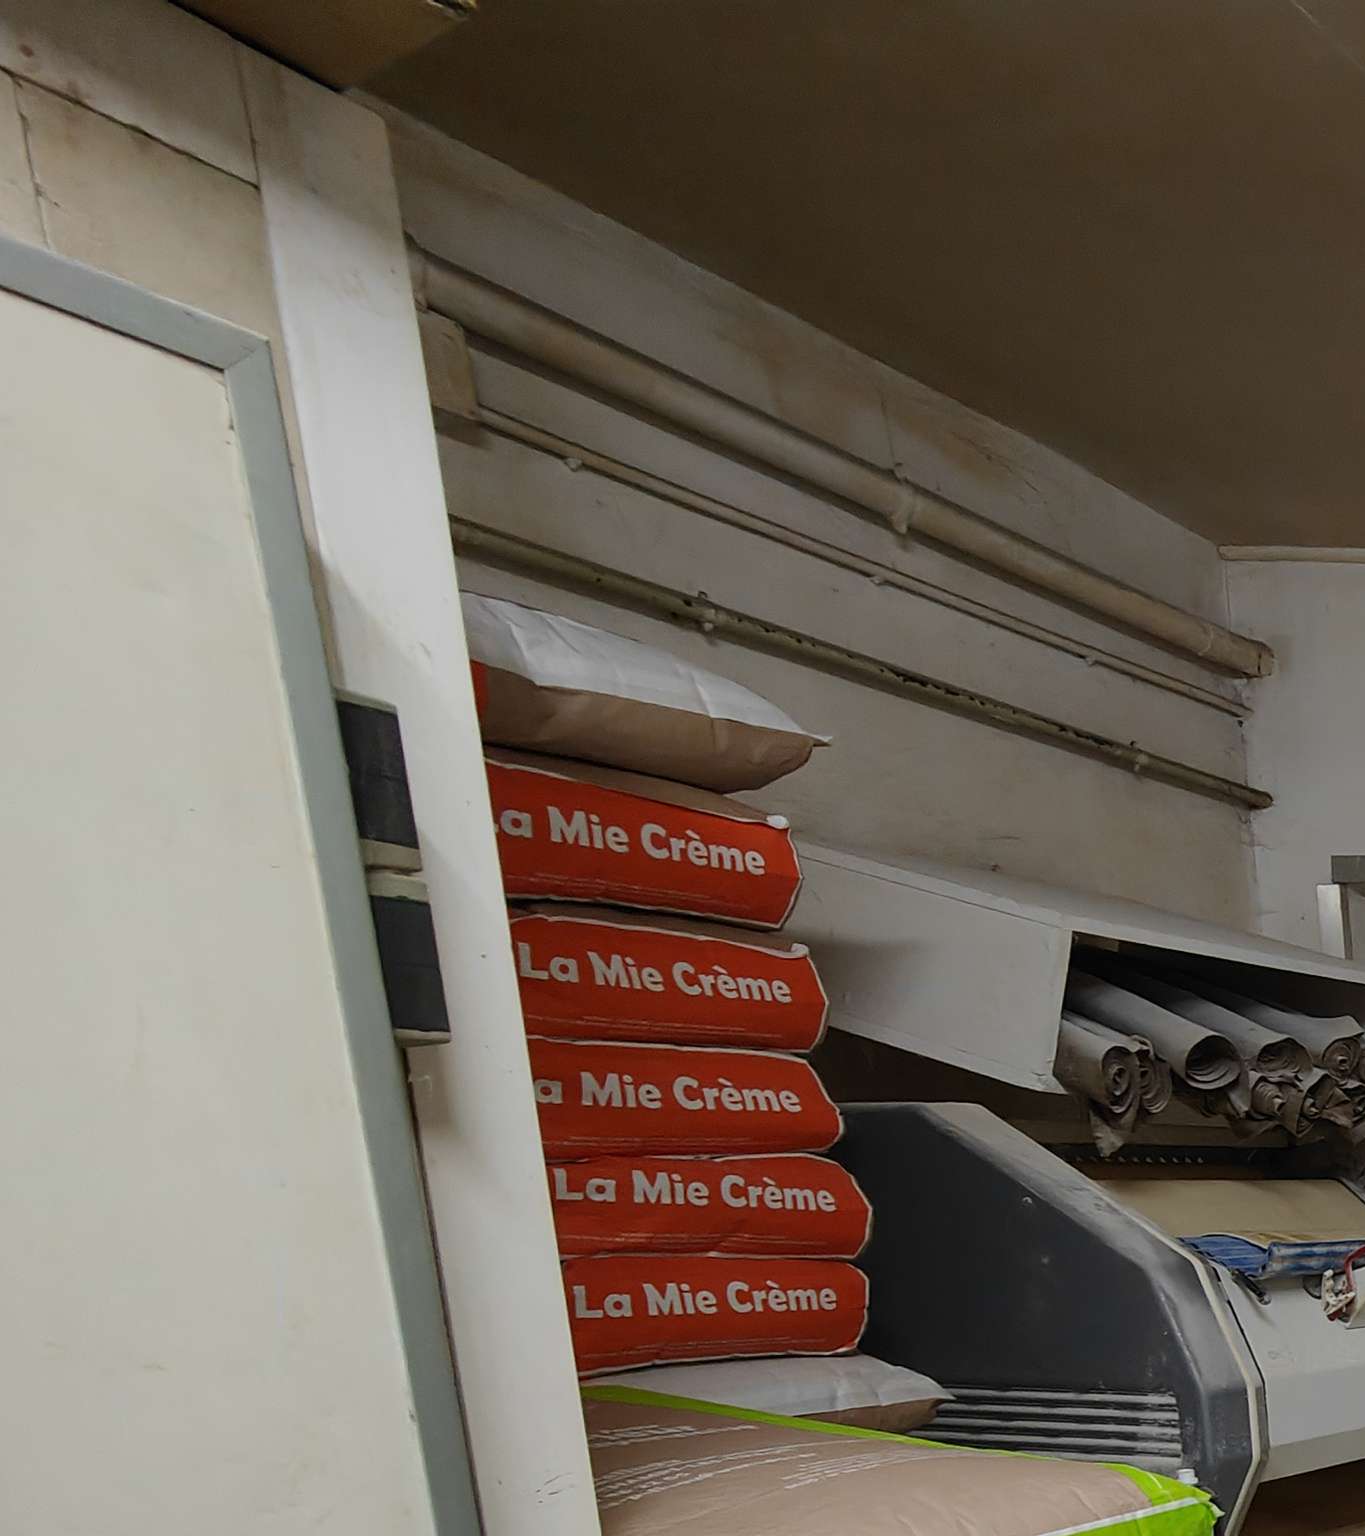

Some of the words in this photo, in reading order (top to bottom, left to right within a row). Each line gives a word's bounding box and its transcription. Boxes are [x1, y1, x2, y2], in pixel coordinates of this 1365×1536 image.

[495, 807, 534, 839] a
[547, 806, 630, 854] Mie
[641, 823, 766, 876] Crème
[517, 942, 578, 984] La
[587, 951, 665, 992] Mie
[672, 961, 792, 1004] Crème
[534, 1079, 563, 1105] a
[580, 1071, 662, 1110] Mie
[672, 1075, 802, 1114] Crème
[553, 1168, 617, 1203] La
[631, 1169, 710, 1207] Mie
[720, 1174, 838, 1213] Crème
[573, 1285, 633, 1320] La
[642, 1282, 718, 1317] Mie
[726, 1279, 838, 1314] Crème
